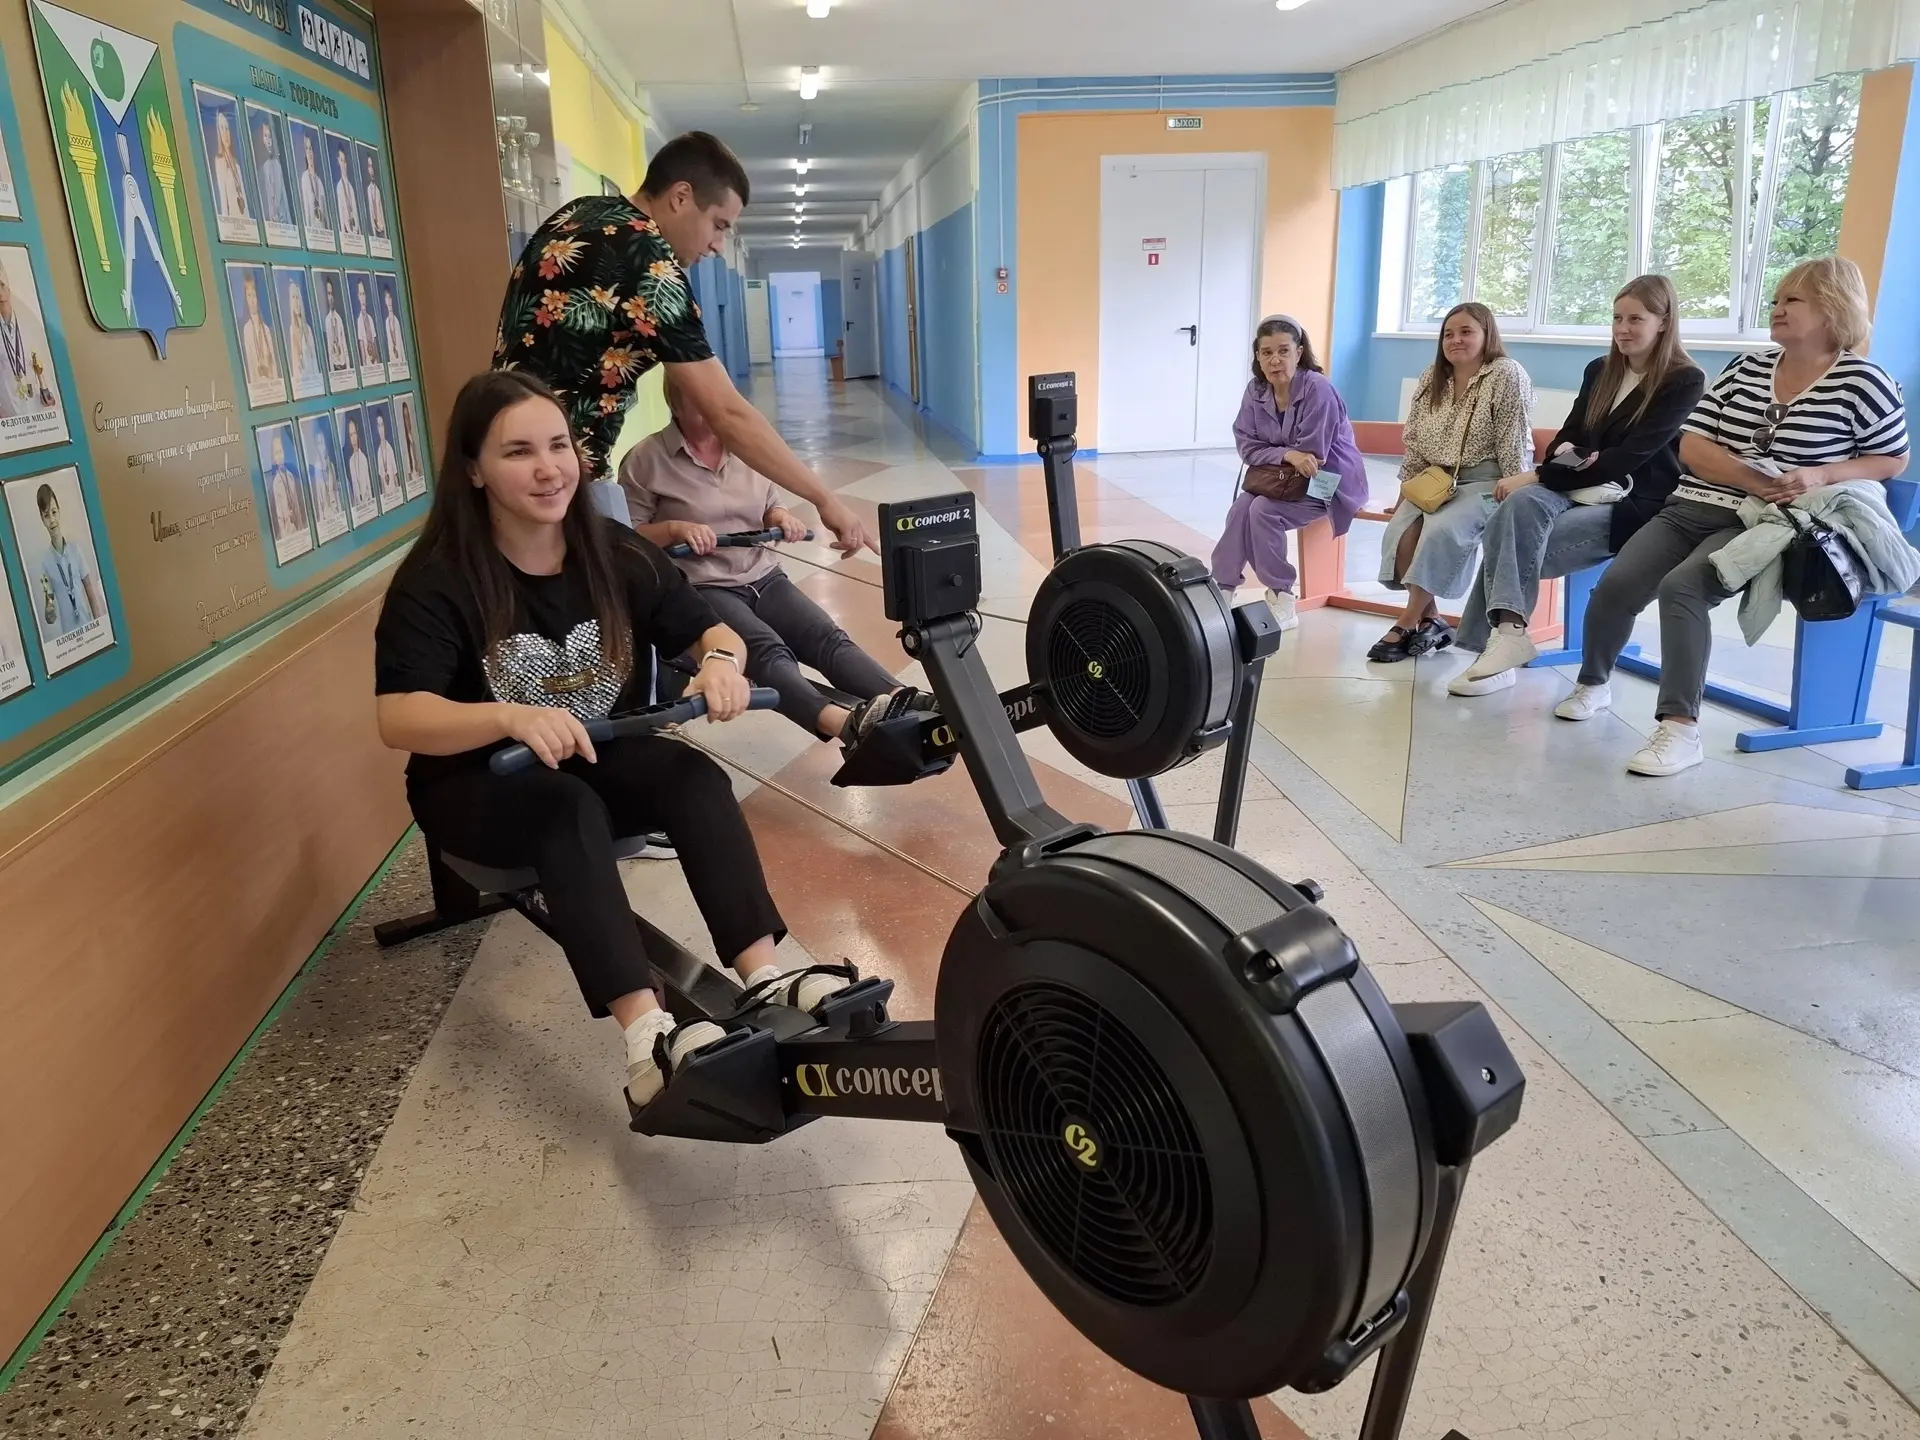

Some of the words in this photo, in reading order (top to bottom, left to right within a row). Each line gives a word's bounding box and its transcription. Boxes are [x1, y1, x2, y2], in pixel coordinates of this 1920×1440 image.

[249, 65, 286, 98] НАША
[289, 81, 339, 119] ГОРДОСТЬ
[1171, 119, 1199, 128] ВЫХОД
[0, 415, 31, 428] ФЕДОТОВ
[31, 411, 57, 422] МИХАИЛ
[93, 399, 129, 438] Спорт
[131, 411, 154, 435] учит
[155, 406, 184, 422] честно
[126, 450, 155, 474] спорт
[157, 445, 178, 469] учит
[179, 444, 185, 455] с
[1694, 490, 1712, 498] PASS
[915, 510, 961, 528] concept
[963, 508, 971, 519] 2
[56, 626, 85, 647] ПЛОЦКИЙ
[84, 619, 101, 633] ИЛЬЯ
[1088, 661, 1103, 678] C2
[1065, 1124, 1097, 1166] C2
